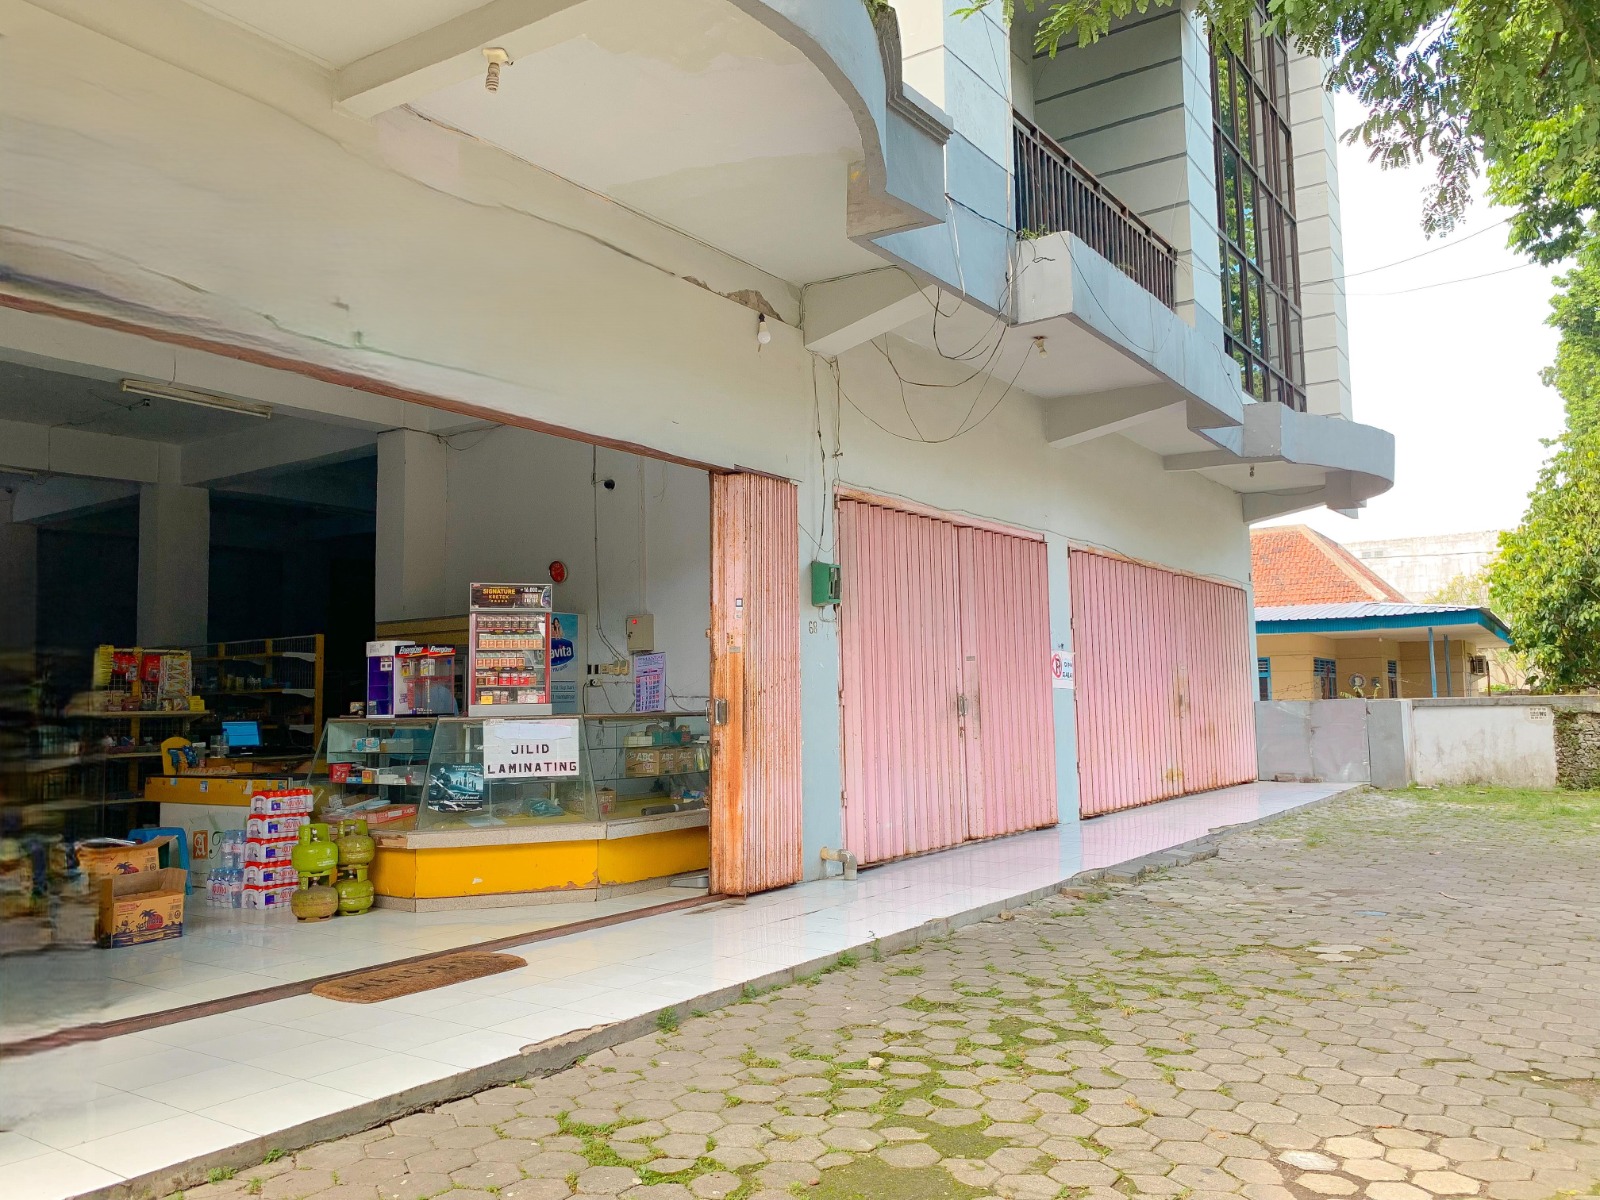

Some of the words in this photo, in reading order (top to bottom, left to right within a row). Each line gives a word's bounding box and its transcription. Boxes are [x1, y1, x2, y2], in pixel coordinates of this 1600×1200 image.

[808, 620, 818, 635] 68
[398, 645, 424, 656] Energizer
[429, 645, 454, 655] Energizer
[511, 744, 550, 755] JILID
[636, 752, 654, 762] ABC
[661, 753, 674, 761] ABC
[487, 761, 577, 775] LAMINATING
